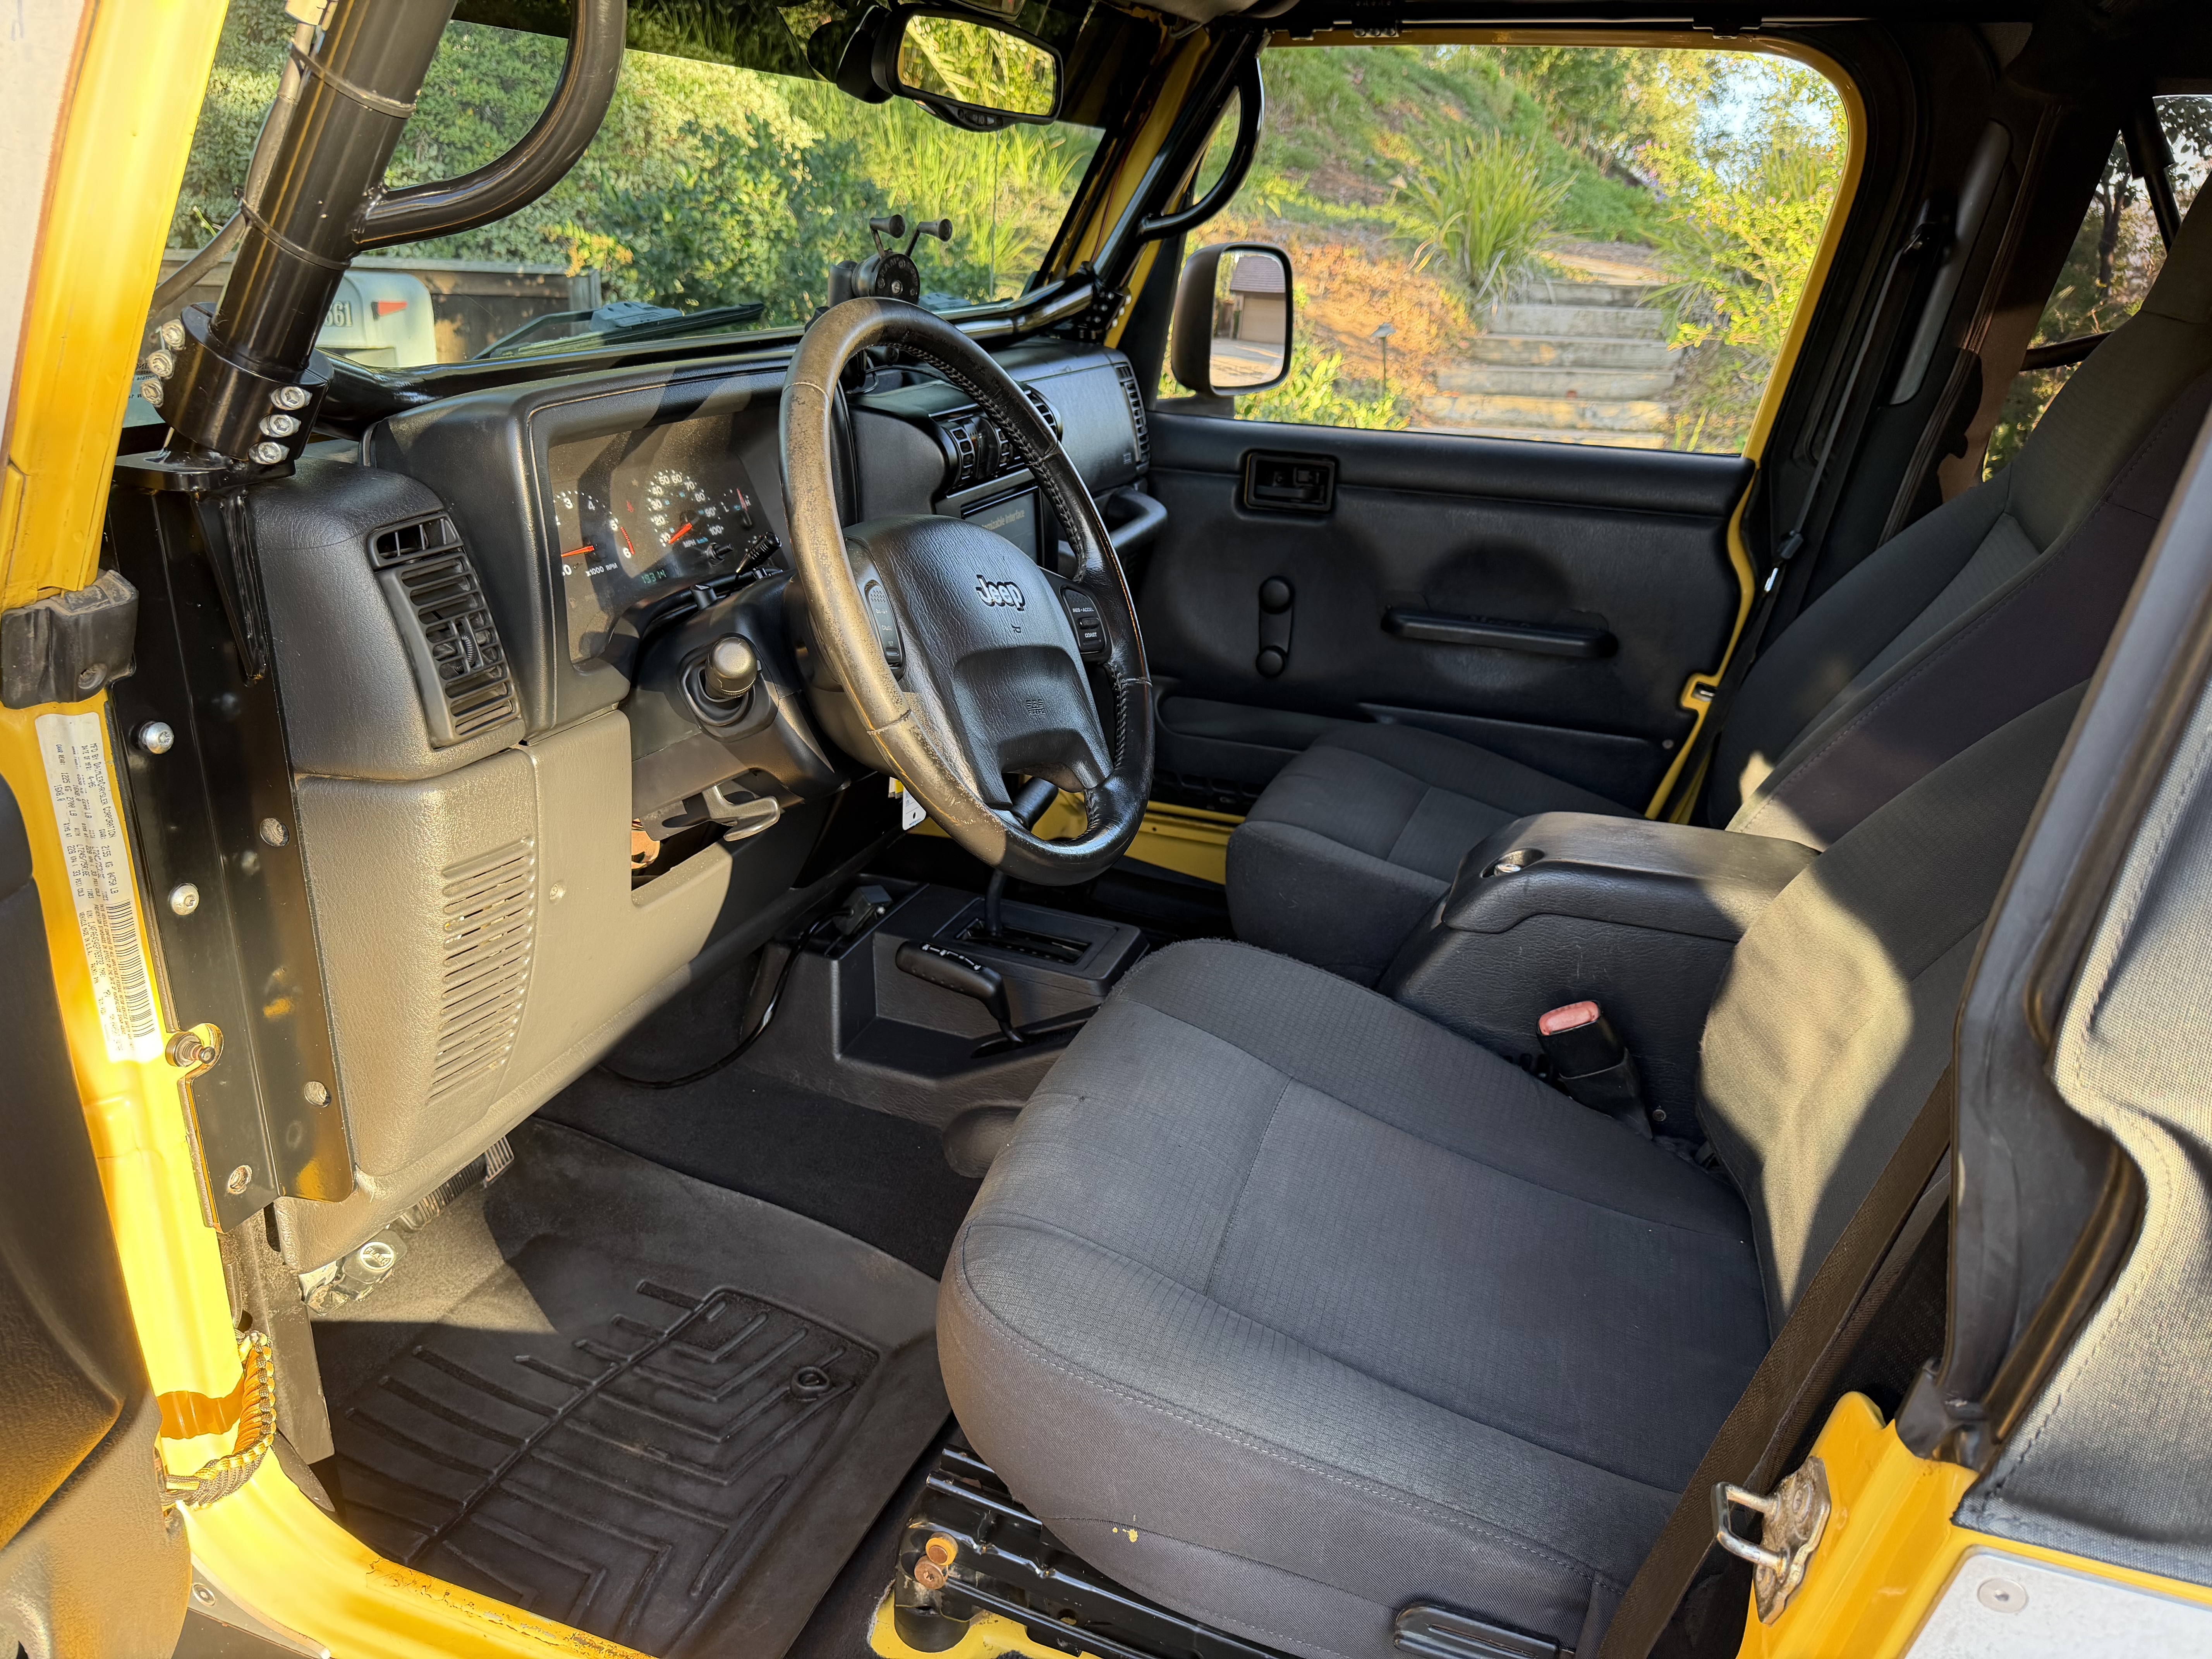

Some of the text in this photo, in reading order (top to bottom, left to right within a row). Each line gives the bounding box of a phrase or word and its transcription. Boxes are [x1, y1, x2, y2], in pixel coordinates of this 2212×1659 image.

[658, 475, 670, 485] 50
[672, 474, 682, 484] 60
[651, 486, 663, 496] 40
[684, 481, 695, 491] 70
[695, 492, 706, 502] 80
[563, 498, 573, 509] 3
[588, 501, 596, 510] 4
[651, 499, 662, 510] 30
[705, 507, 715, 517] 90
[1005, 510, 1025, 524] Interface
[653, 514, 665, 526] 20
[709, 525, 722, 536] 100
[660, 532, 671, 542] 10
[683, 539, 696, 548] MPH
[623, 547, 631, 558] 6
[563, 564, 572, 575] 0
[586, 562, 618, 577] x1000 RPM
[642, 569, 666, 584] 19314
[975, 575, 1025, 611] Jeep
[87, 776, 96, 788] 4-06
[54, 784, 65, 801] 16X8.0
[61, 773, 70, 783] 1225
[66, 797, 75, 808] 2700
[90, 743, 98, 752] MFD
[103, 806, 116, 838] CORPORATION
[67, 845, 76, 854] 228
[101, 845, 111, 857] 2155
[107, 872, 117, 886] 04750
